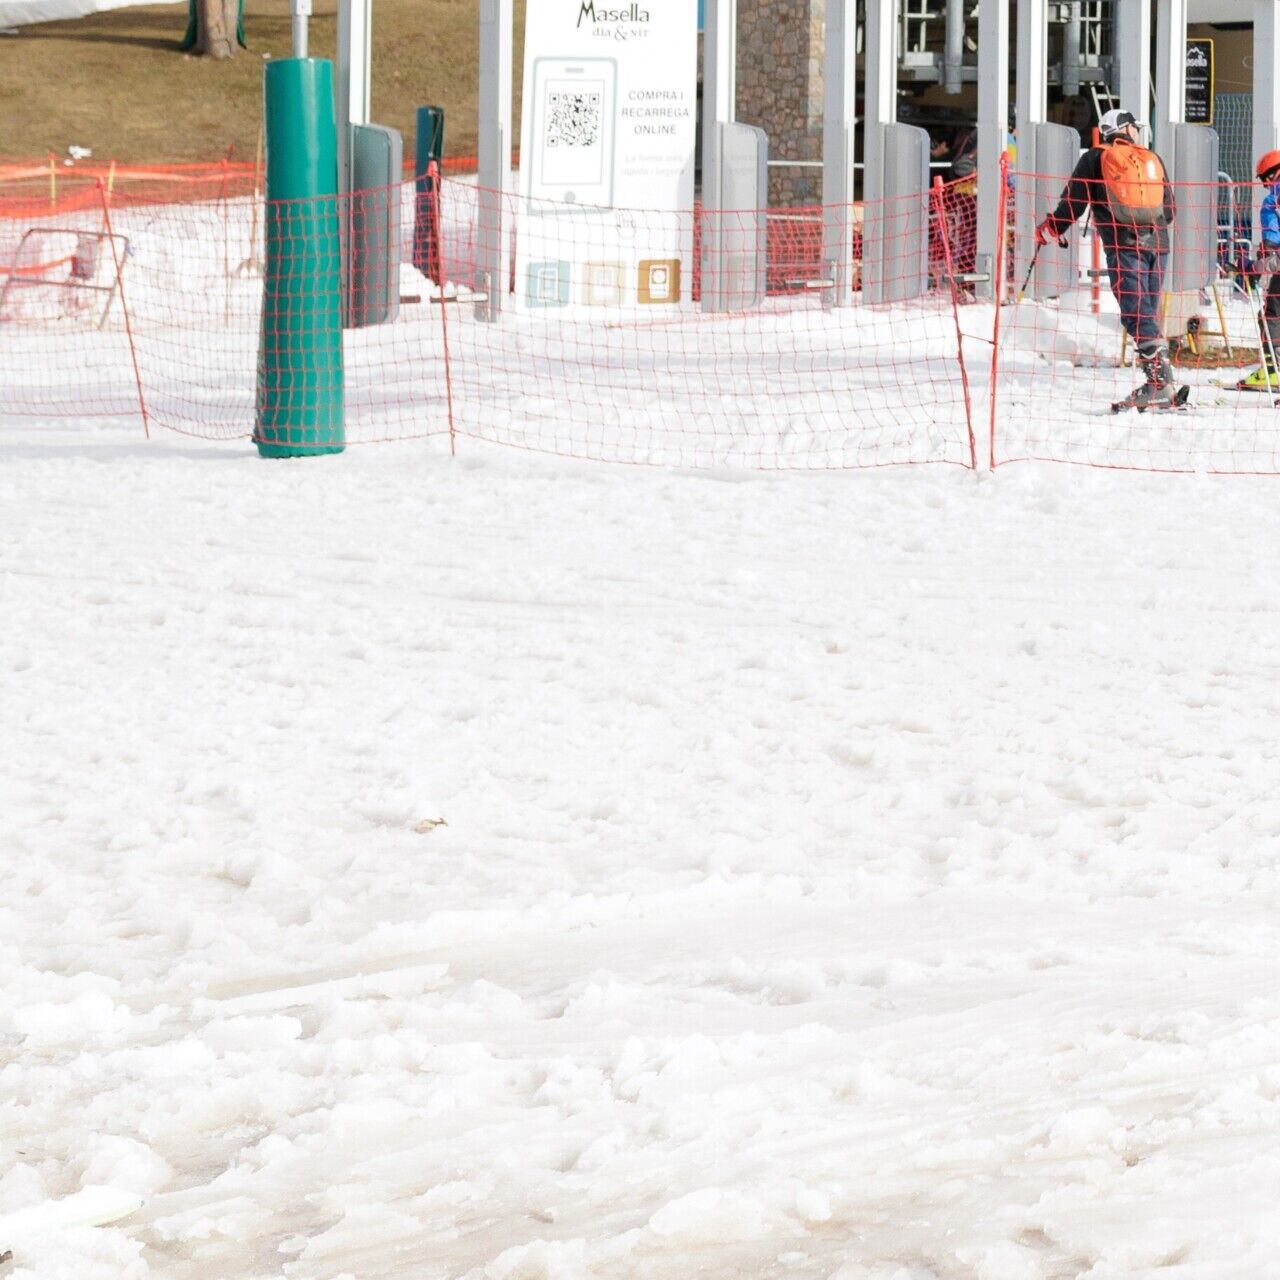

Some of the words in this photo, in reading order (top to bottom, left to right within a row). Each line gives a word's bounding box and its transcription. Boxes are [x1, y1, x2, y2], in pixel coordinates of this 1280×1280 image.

[628, 90, 676, 101] COMPRA
[621, 107, 689, 118] RECARREGA
[634, 124, 677, 135] ONLINE
